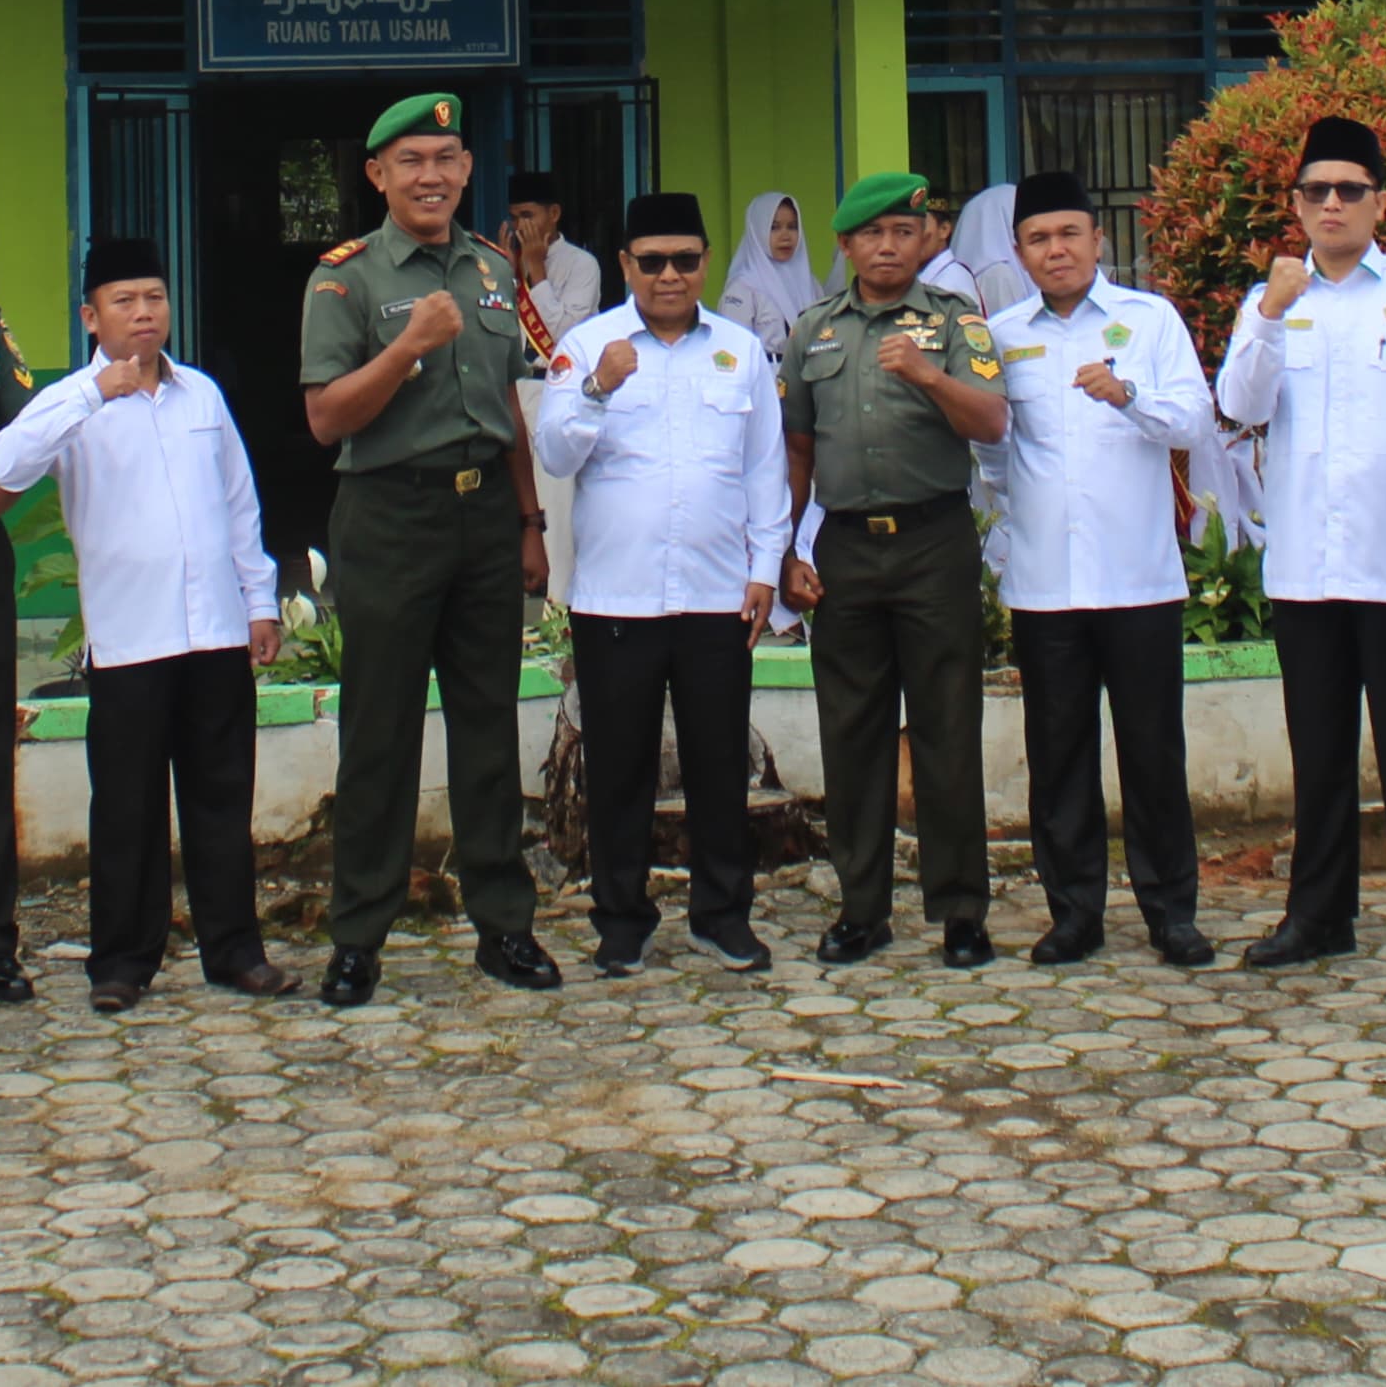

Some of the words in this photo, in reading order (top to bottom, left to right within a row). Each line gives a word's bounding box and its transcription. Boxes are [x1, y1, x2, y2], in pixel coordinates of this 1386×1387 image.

[267, 19, 331, 44] RUANG
[339, 19, 381, 43] TATA
[389, 18, 452, 42] USAHA
